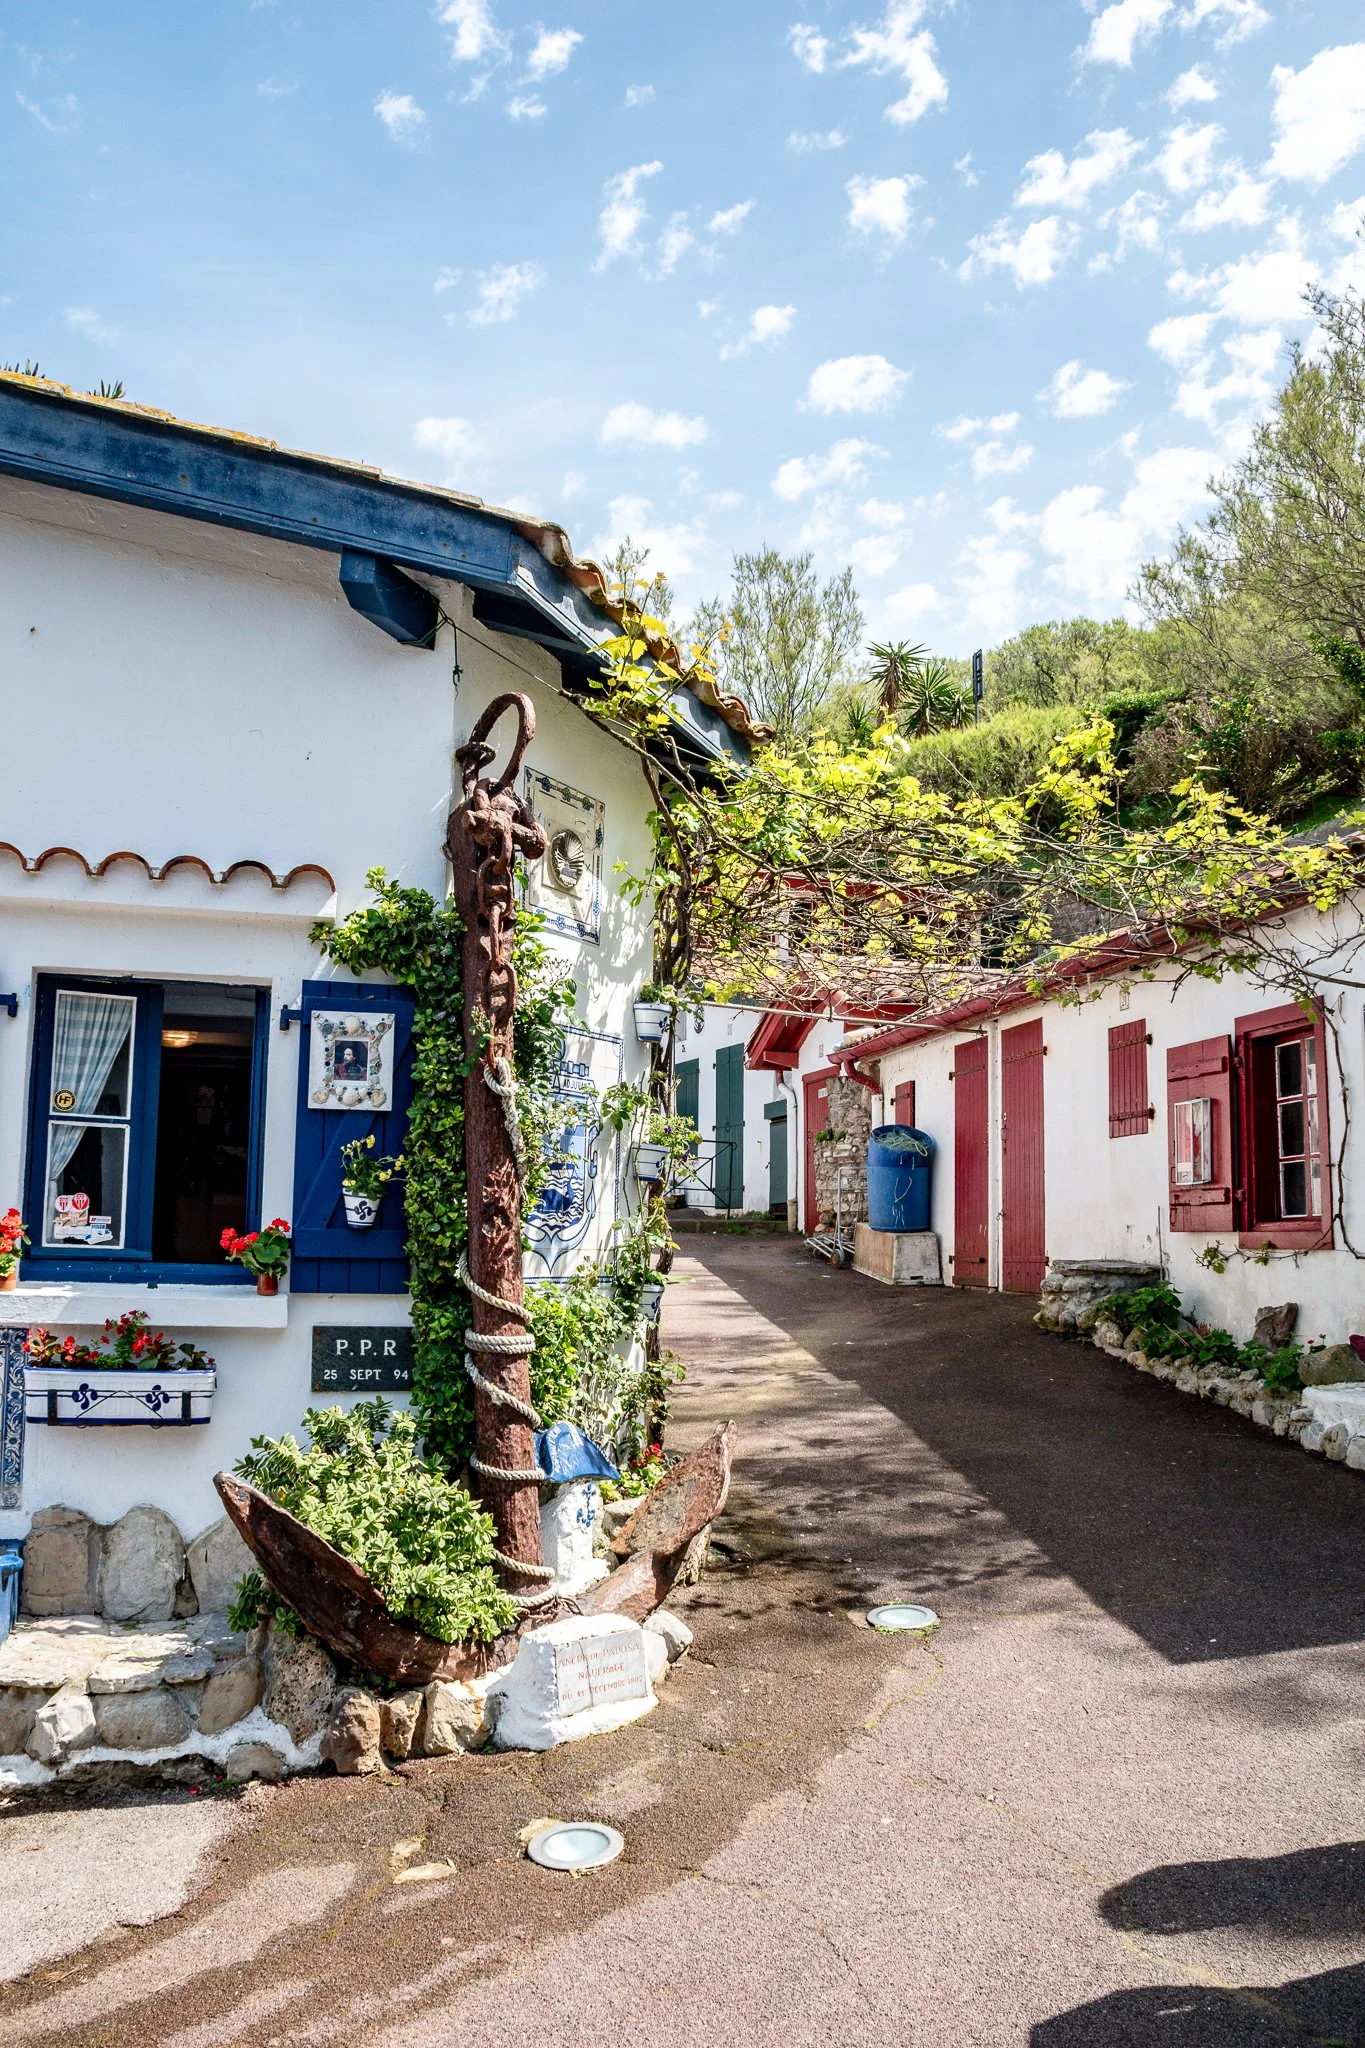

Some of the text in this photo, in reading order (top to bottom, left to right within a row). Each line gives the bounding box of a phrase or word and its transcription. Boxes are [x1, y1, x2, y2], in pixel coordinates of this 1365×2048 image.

[323, 1369, 409, 1380] 25 SEPT 94
